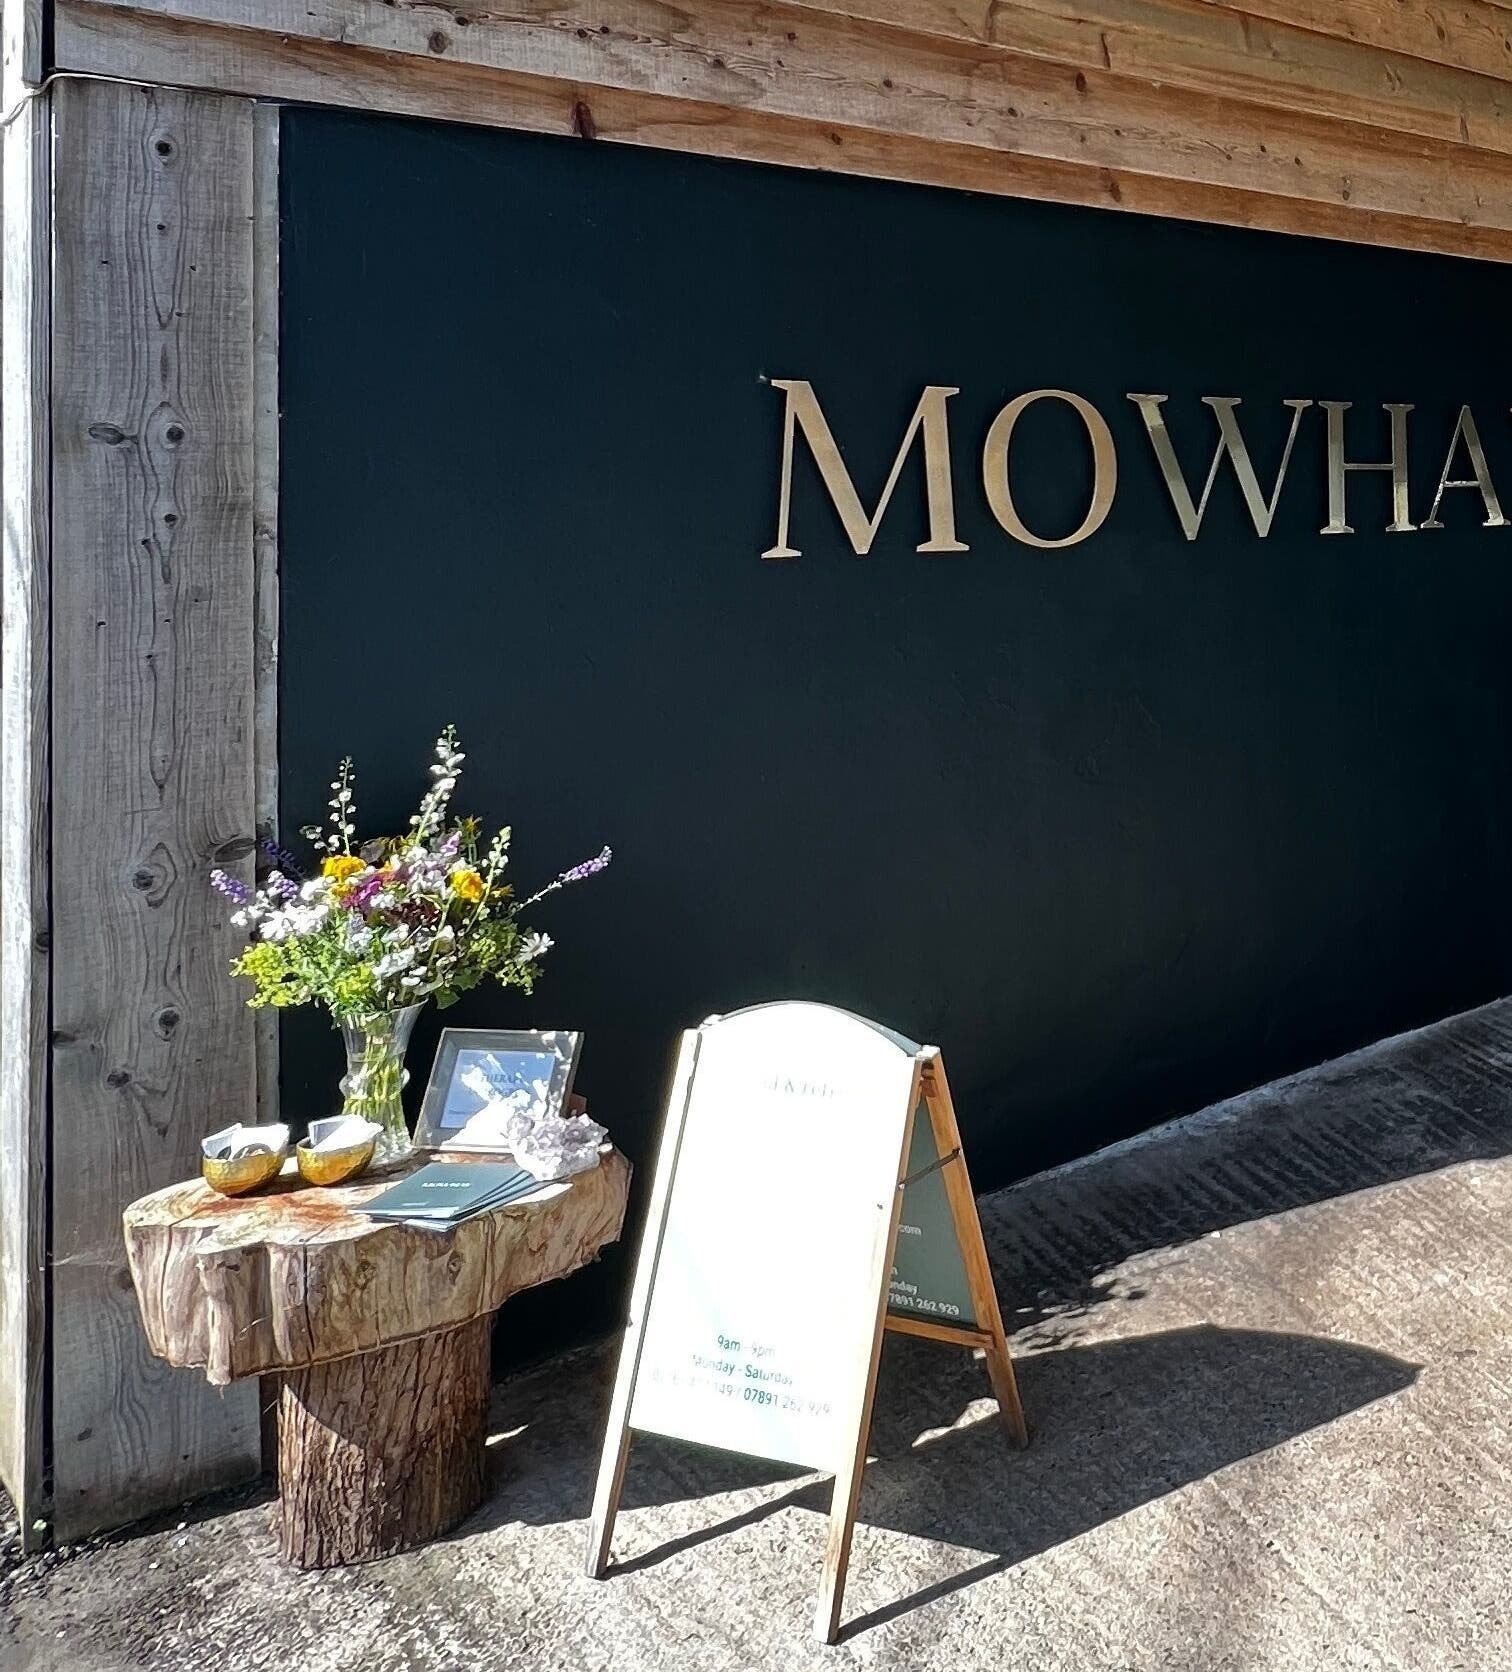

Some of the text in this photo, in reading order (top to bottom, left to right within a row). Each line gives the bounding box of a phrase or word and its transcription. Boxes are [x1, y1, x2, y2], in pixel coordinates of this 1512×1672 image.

[889, 1292, 960, 1316] 7891 262 929
[717, 1334, 741, 1352] 9am
[743, 1387, 778, 1406] 07891
